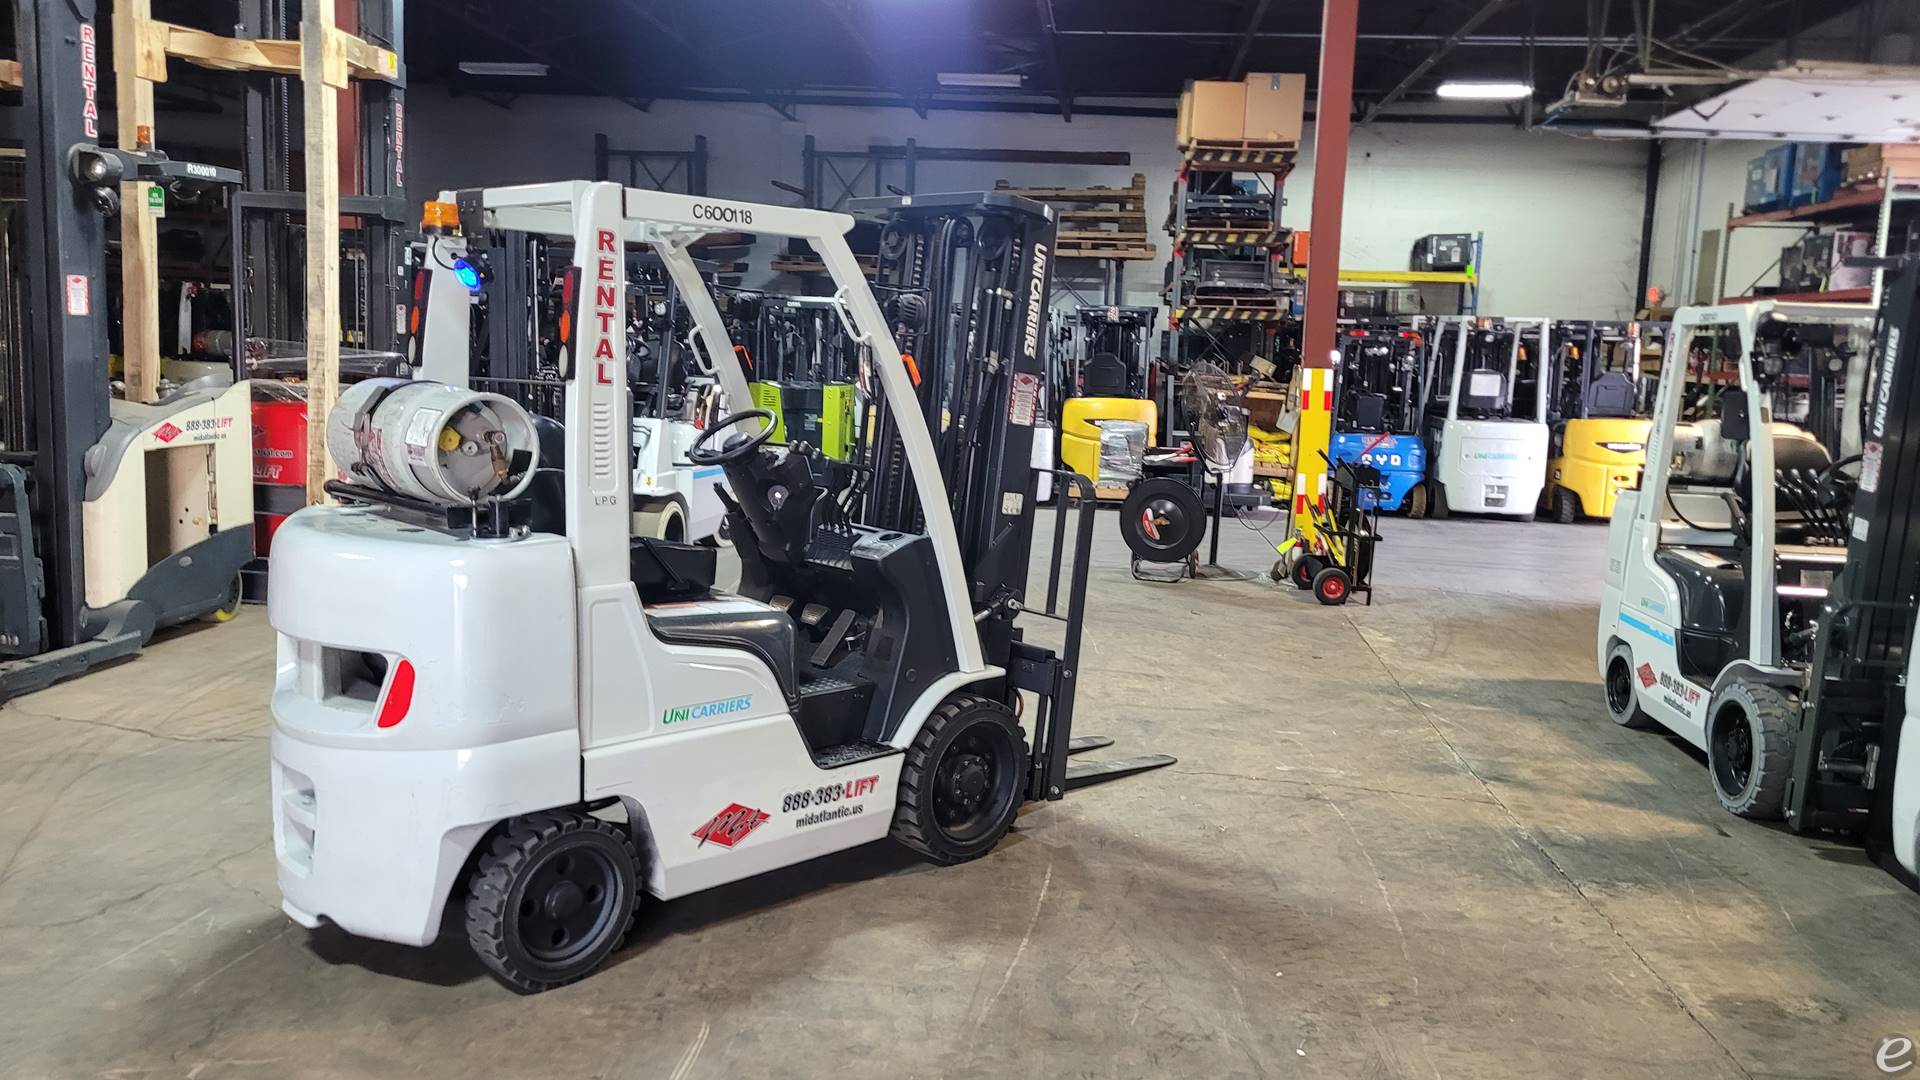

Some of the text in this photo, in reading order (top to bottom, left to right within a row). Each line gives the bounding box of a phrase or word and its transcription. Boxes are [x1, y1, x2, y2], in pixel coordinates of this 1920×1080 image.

[81, 23, 98, 138] RENTAL
[692, 203, 753, 225] C600118
[595, 229, 616, 385] RENTAL
[1024, 242, 1047, 360] UNICARRIERS
[594, 495, 617, 505] LPG
[795, 803, 864, 829] midatlantic.us
